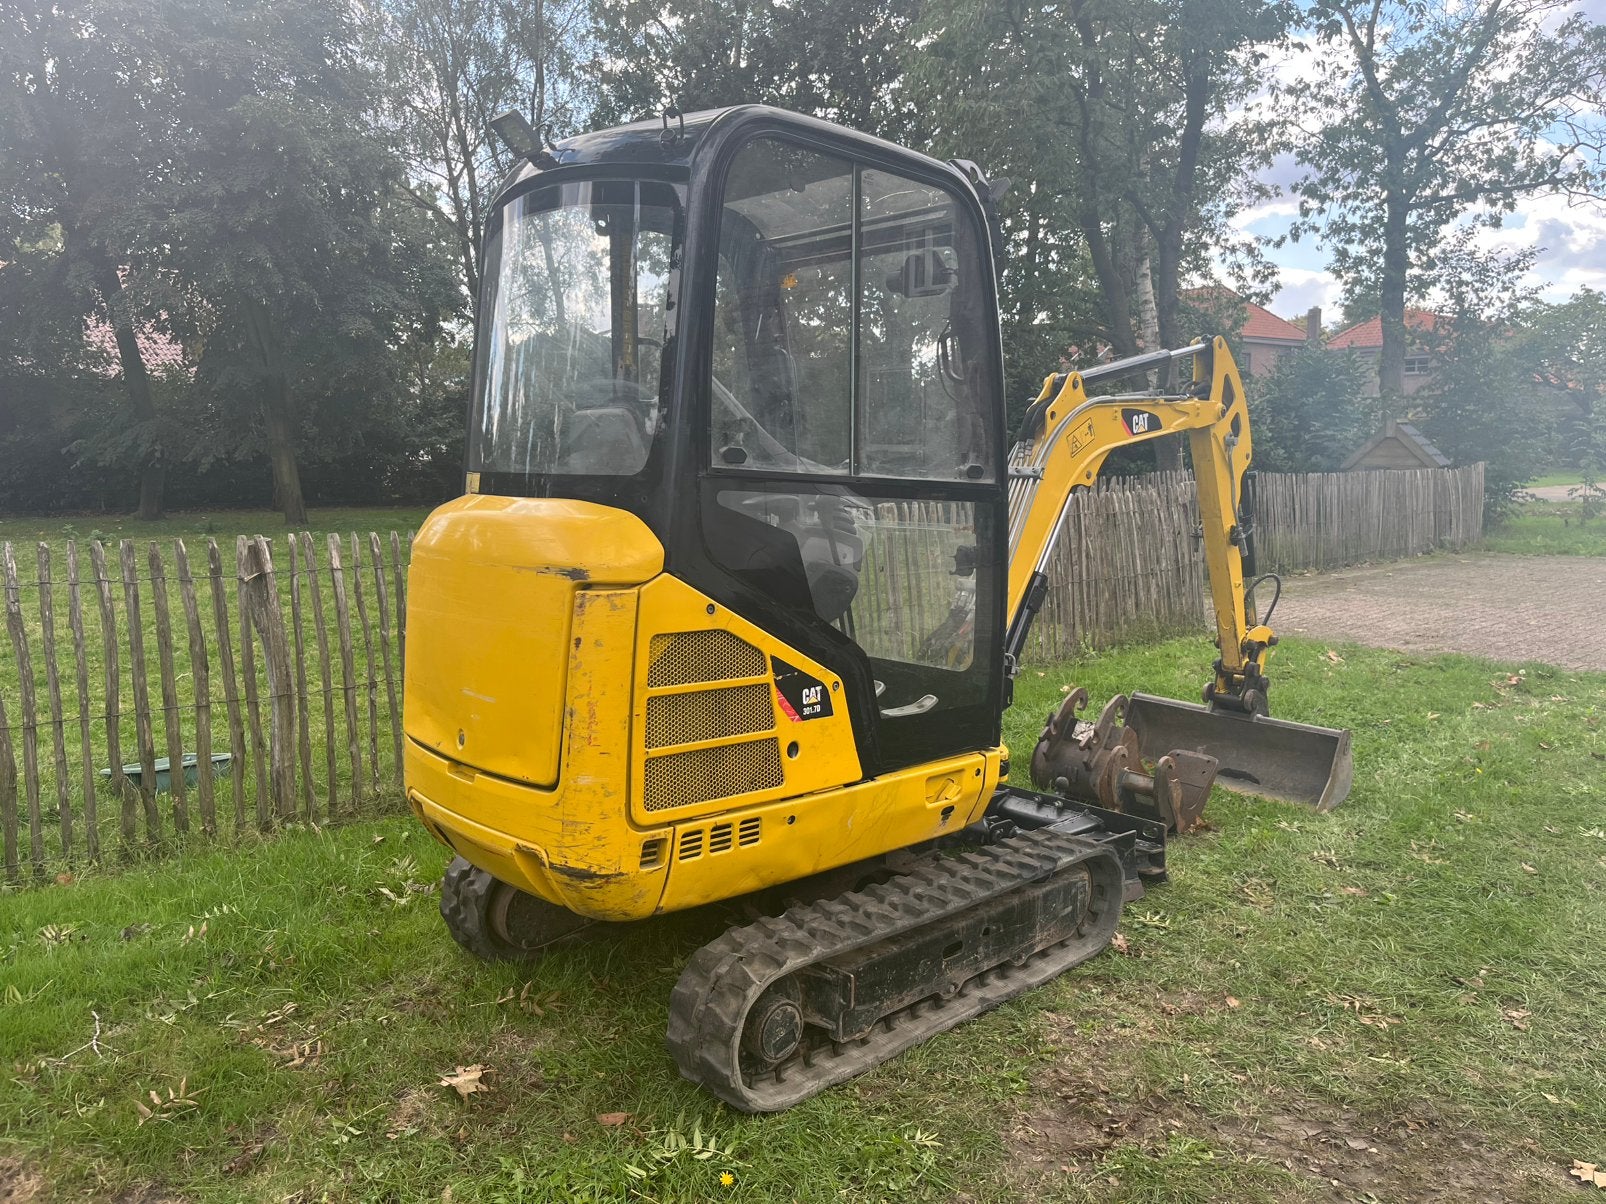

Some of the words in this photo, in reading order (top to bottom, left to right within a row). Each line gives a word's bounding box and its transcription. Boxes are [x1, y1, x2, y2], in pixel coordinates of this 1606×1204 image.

[1132, 413, 1149, 433] CAT
[802, 685, 822, 704] CAT
[803, 704, 821, 715] 301.7D
